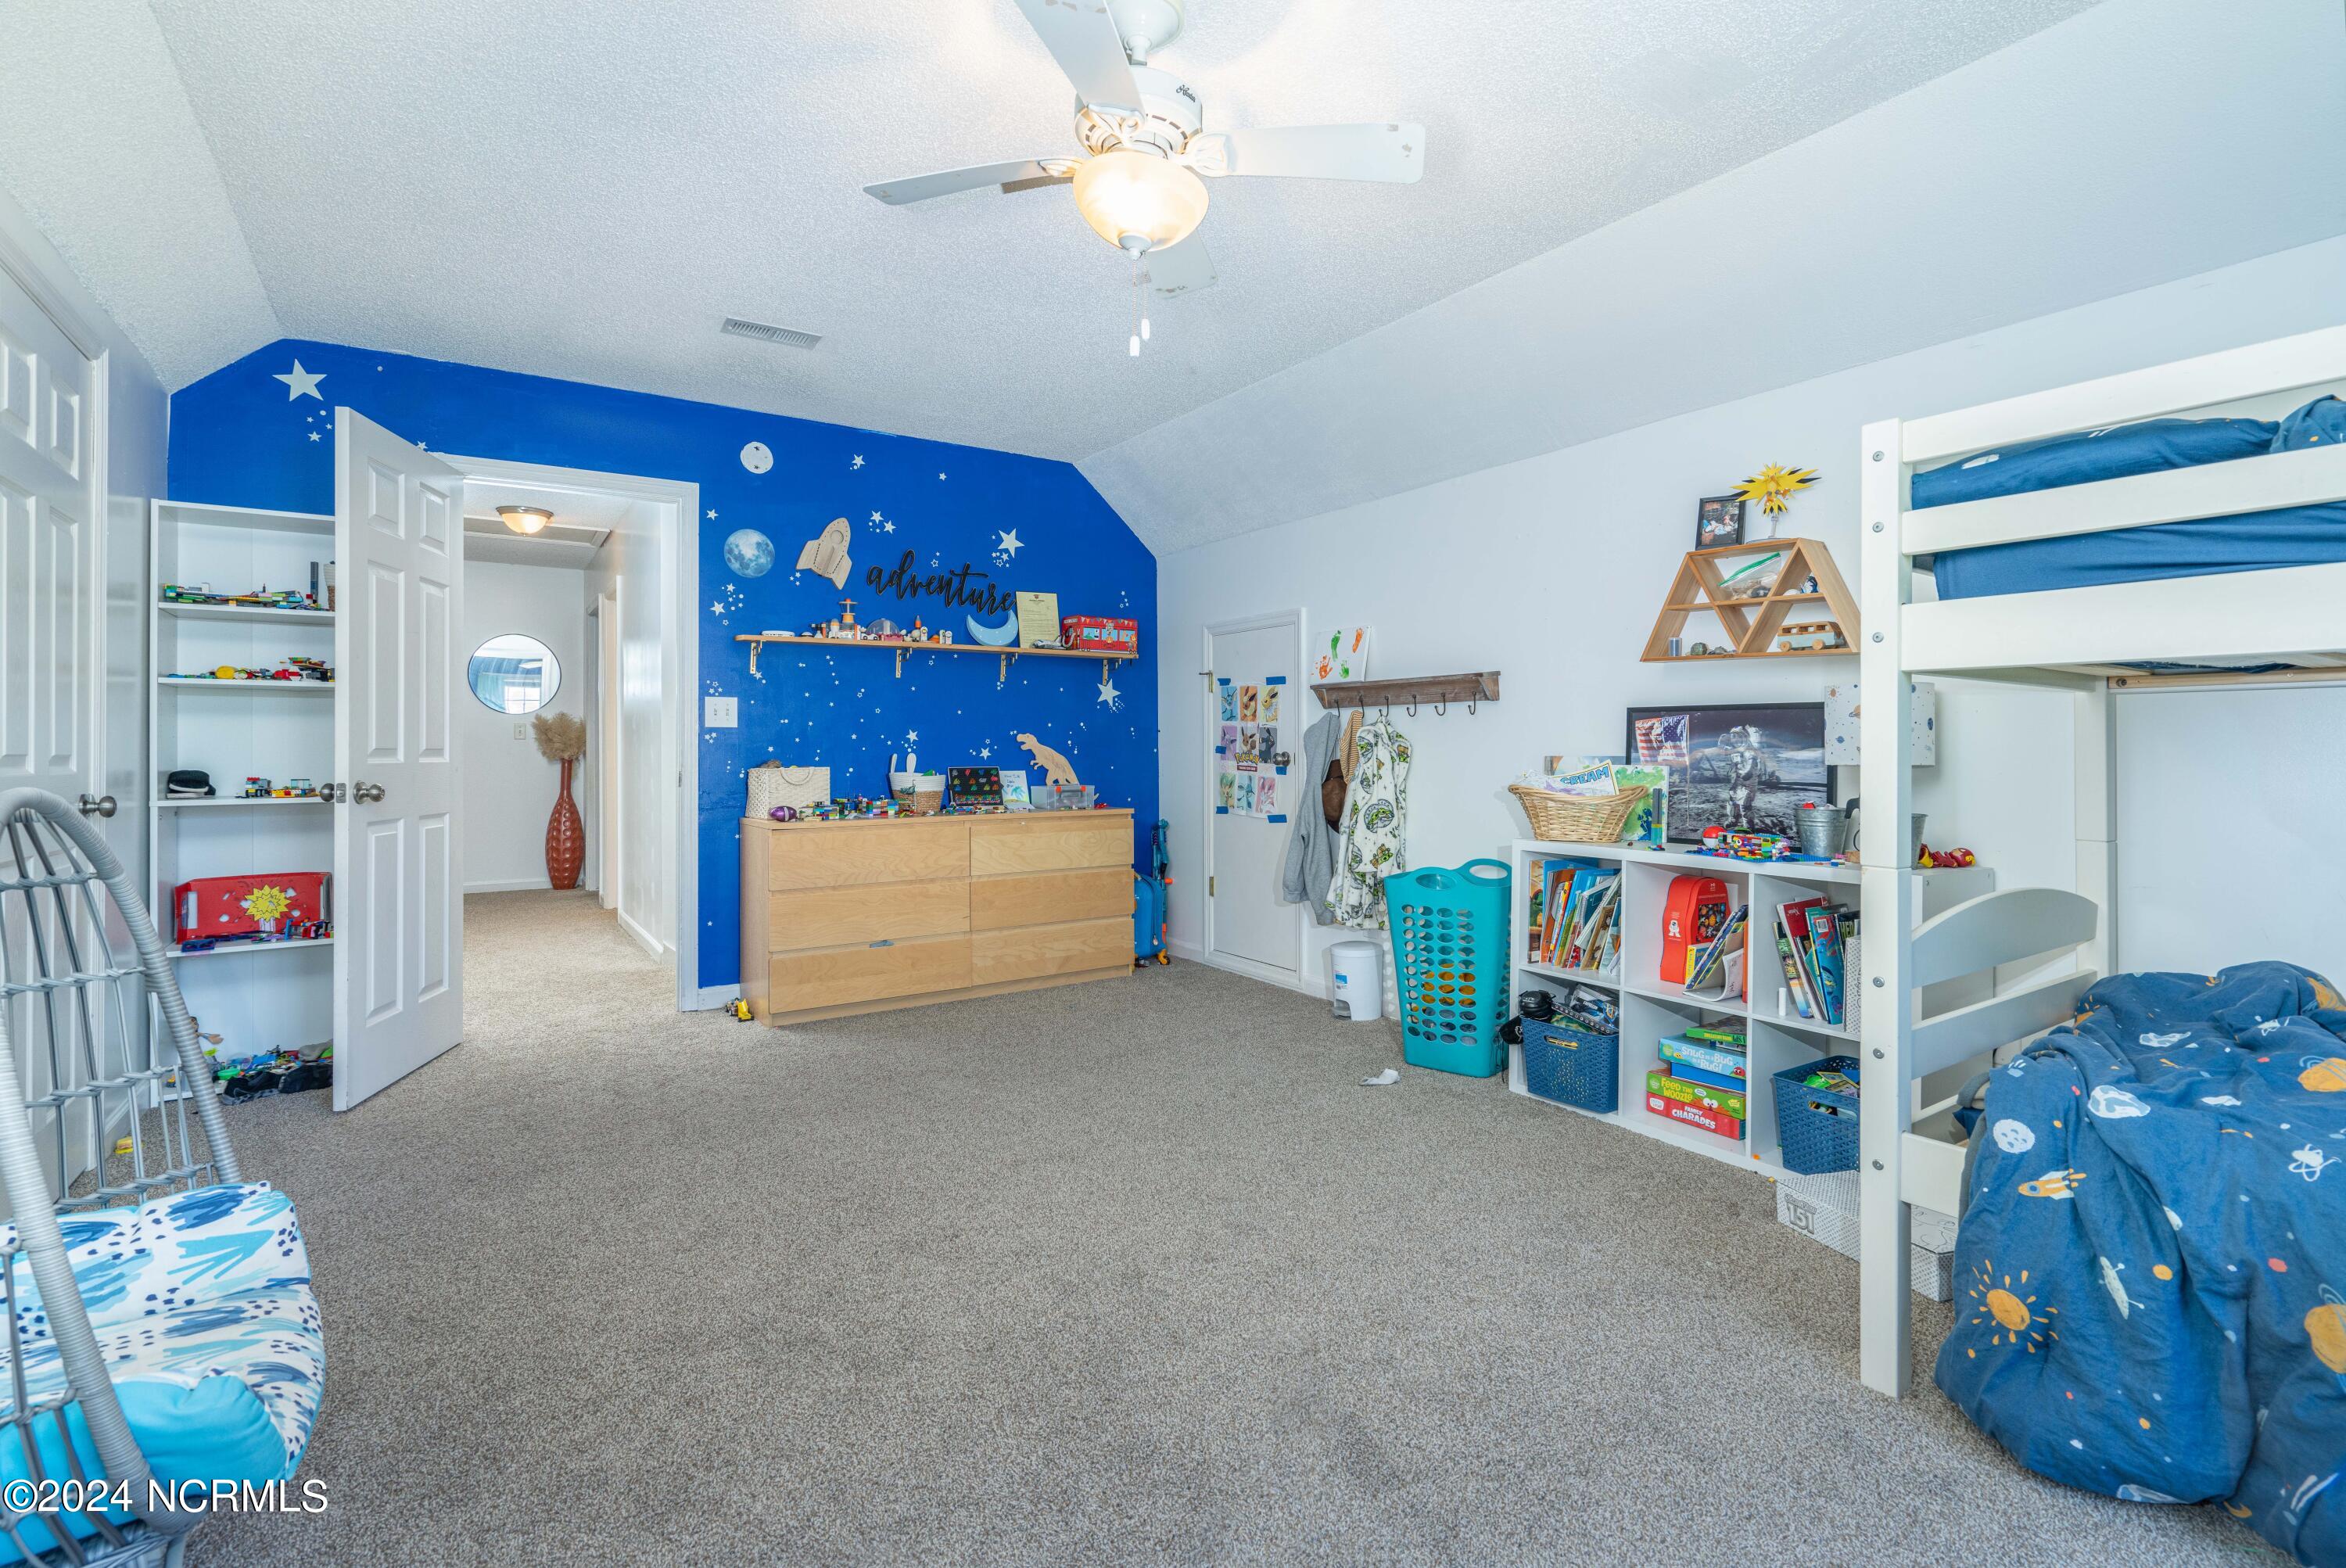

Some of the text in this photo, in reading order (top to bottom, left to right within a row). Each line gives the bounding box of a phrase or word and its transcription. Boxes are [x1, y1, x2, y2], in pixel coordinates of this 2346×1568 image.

[866, 549, 1017, 616] adventure
[1559, 766, 1610, 785] CREAM
[1671, 1109, 1716, 1129] CHARADES
[1684, 1106, 1704, 1115] FAMILY
[1788, 1204, 1815, 1235] 151
